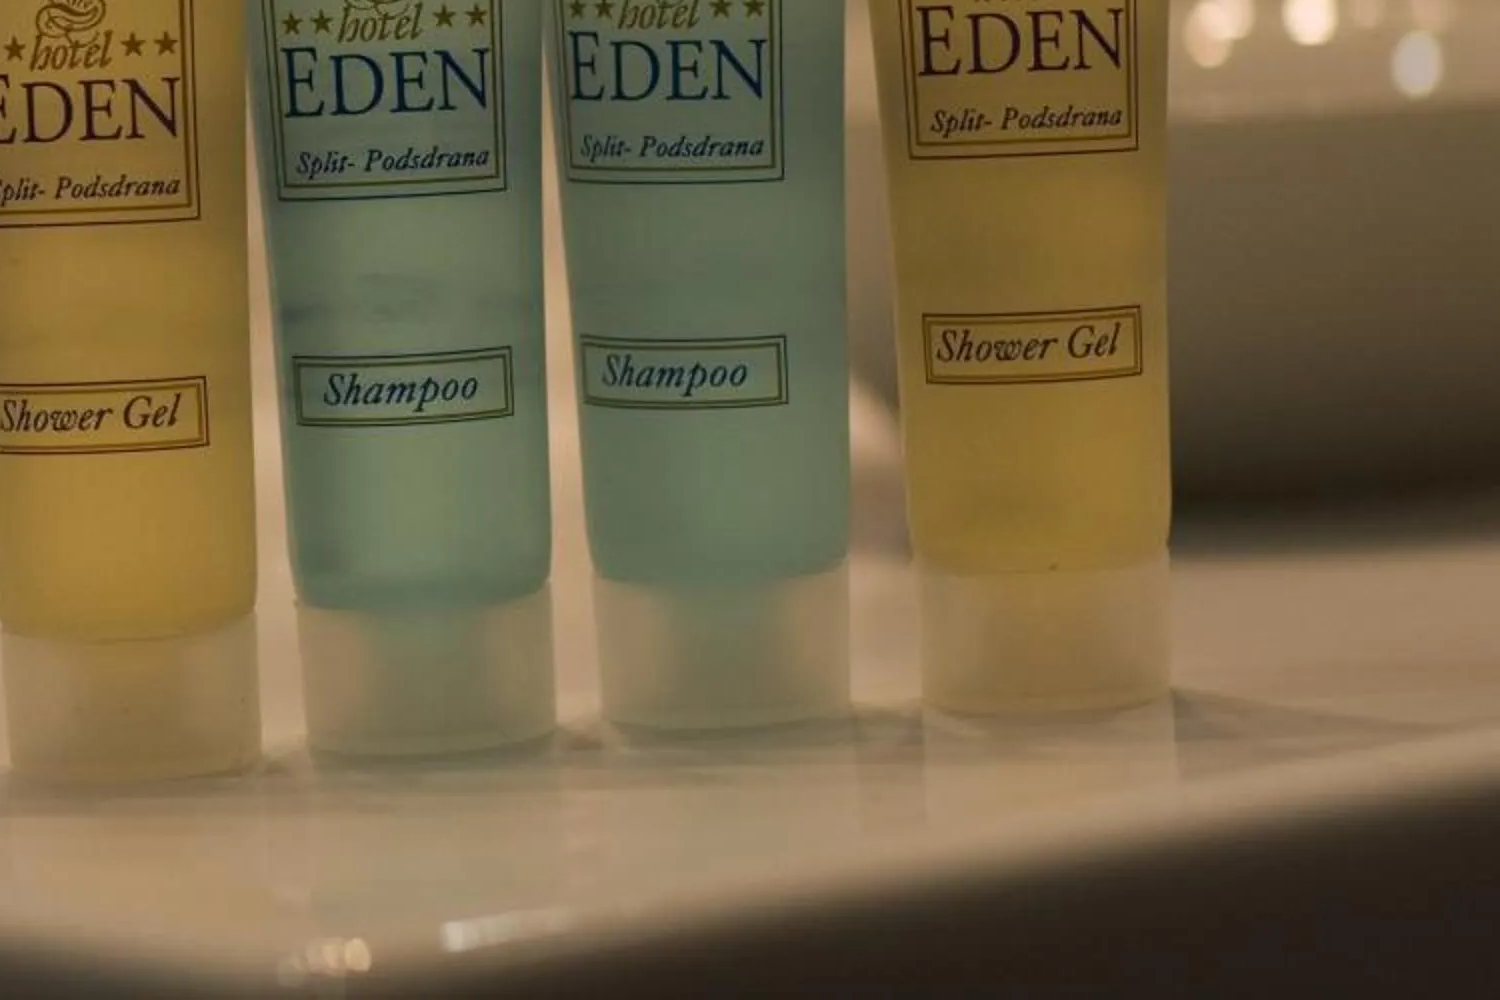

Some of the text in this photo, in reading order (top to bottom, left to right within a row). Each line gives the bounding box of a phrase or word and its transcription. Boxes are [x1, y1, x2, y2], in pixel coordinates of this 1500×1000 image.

[338, 3, 424, 43] hotel
[916, 5, 1124, 76] EDEN
[29, 30, 114, 72] hotel
[568, 31, 767, 101] EDEN
[280, 47, 489, 118] EDEN
[1000, 106, 1122, 130] Podsdrana
[364, 146, 488, 173] Podsdrana
[640, 135, 763, 158] Podsdrana
[55, 174, 180, 199] Podsdrana
[936, 321, 1121, 363] Shower Gel
[324, 373, 478, 413] Shampoo
[602, 354, 748, 398] Shampoo
[0, 393, 181, 433] Shower Gel
